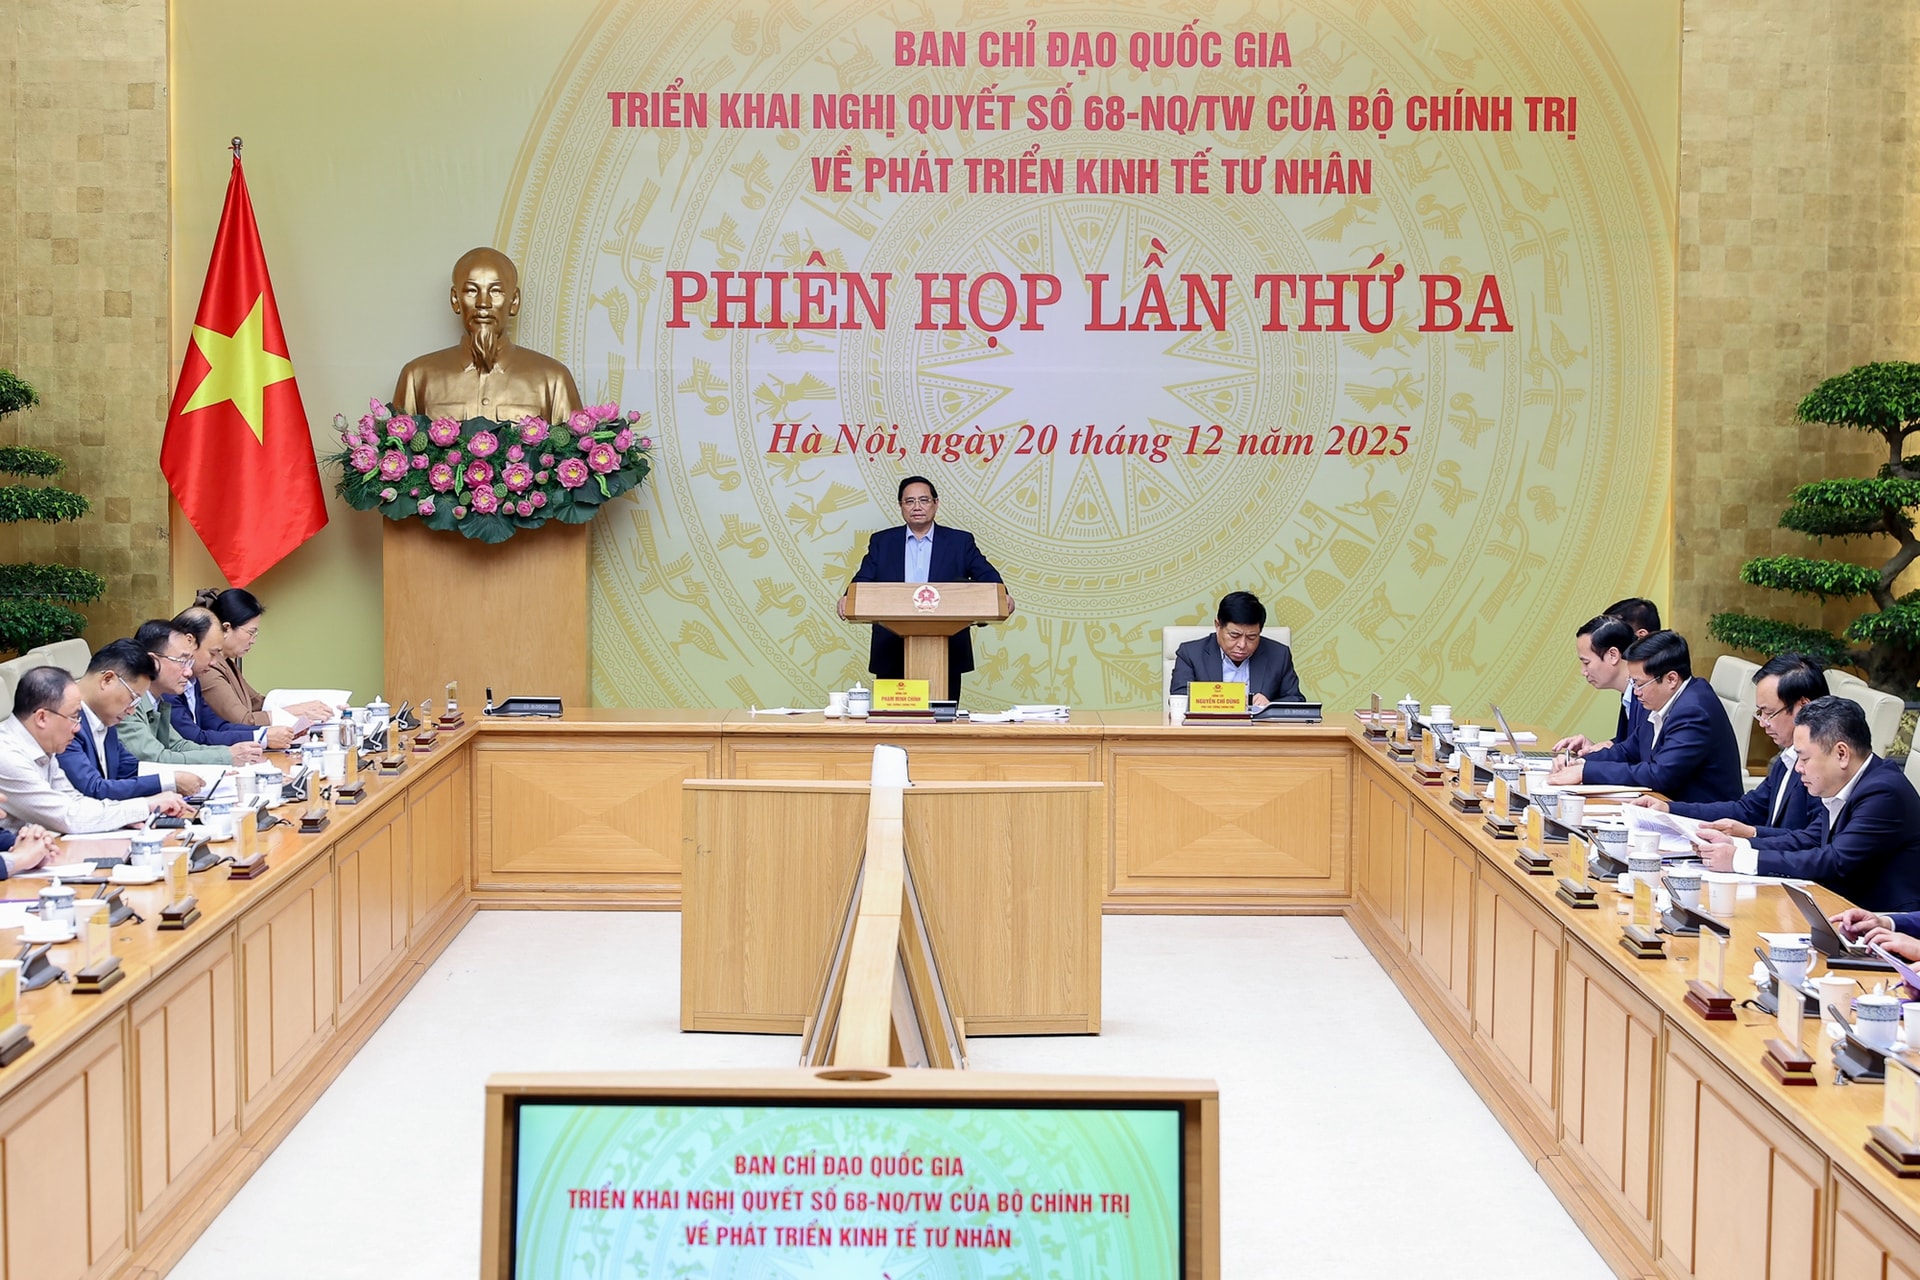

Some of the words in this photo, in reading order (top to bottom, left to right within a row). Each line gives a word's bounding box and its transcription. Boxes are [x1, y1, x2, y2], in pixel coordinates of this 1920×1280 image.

[895, 31, 966, 67] BAN
[979, 19, 1037, 67] CHỈ
[1047, 31, 1117, 76] ĐẠO
[1129, 19, 1222, 72] QUỐC
[1235, 31, 1292, 68] GIA
[607, 78, 708, 128] TRIỂN
[720, 93, 800, 129] KHAI
[813, 93, 895, 138] NGHỊ
[908, 84, 1016, 134] QUYẾT
[1027, 82, 1073, 131] SỐ
[1084, 95, 1255, 135] 68-NQ/TW
[1267, 83, 1336, 132] CỦA
[1348, 88, 1394, 140] BỘ
[1406, 88, 1513, 132] CHÍNH
[1524, 96, 1577, 141] TRỊ
[811, 145, 852, 193] VỀ
[865, 151, 953, 193] PHÁT
[964, 143, 1064, 194] TRIỂN
[1077, 159, 1159, 194] KINH
[1171, 147, 1211, 195] TẾ
[1221, 155, 1267, 195] TƯ
[1275, 151, 1372, 195] NHÂN
[666, 251, 892, 329] PHIÊN
[914, 271, 1062, 348] HỌP
[1084, 238, 1232, 332] LẦN
[1254, 253, 1405, 334] THỨ
[1418, 274, 1514, 333] BA
[768, 423, 822, 454] Hà
[833, 424, 908, 460] Nội,
[920, 430, 1005, 463] ngày
[1015, 424, 1058, 455] 20
[1070, 425, 1171, 462] tháng
[1186, 425, 1223, 455] 12
[1237, 430, 1313, 455] năm
[1326, 425, 1411, 456] 2025
[735, 1156, 776, 1175] BAN
[783, 1149, 816, 1175] CHỈ
[823, 1156, 863, 1180] ĐẠO
[870, 1149, 923, 1178] QUỐC
[931, 1156, 964, 1177] GIA
[568, 1181, 625, 1209] TRIỂN
[632, 1190, 679, 1209] KHAI
[687, 1190, 735, 1216] NGHỊ
[742, 1184, 803, 1211] QUYẾT
[811, 1183, 837, 1211] SỐ
[844, 1192, 942, 1213] 68-NQ/TW
[950, 1186, 990, 1212] CỦA
[997, 1188, 1023, 1217] BỘ
[1031, 1189, 1093, 1213] CHÍNH
[1100, 1193, 1129, 1219] TRỊ
[716, 1222, 767, 1246] PHÁT
[775, 1219, 832, 1246] TRIỂN
[840, 1228, 888, 1247] KINH
[895, 1221, 917, 1247] TẾ
[924, 1227, 950, 1247] TƯ
[955, 1225, 1011, 1248] NHÂN
